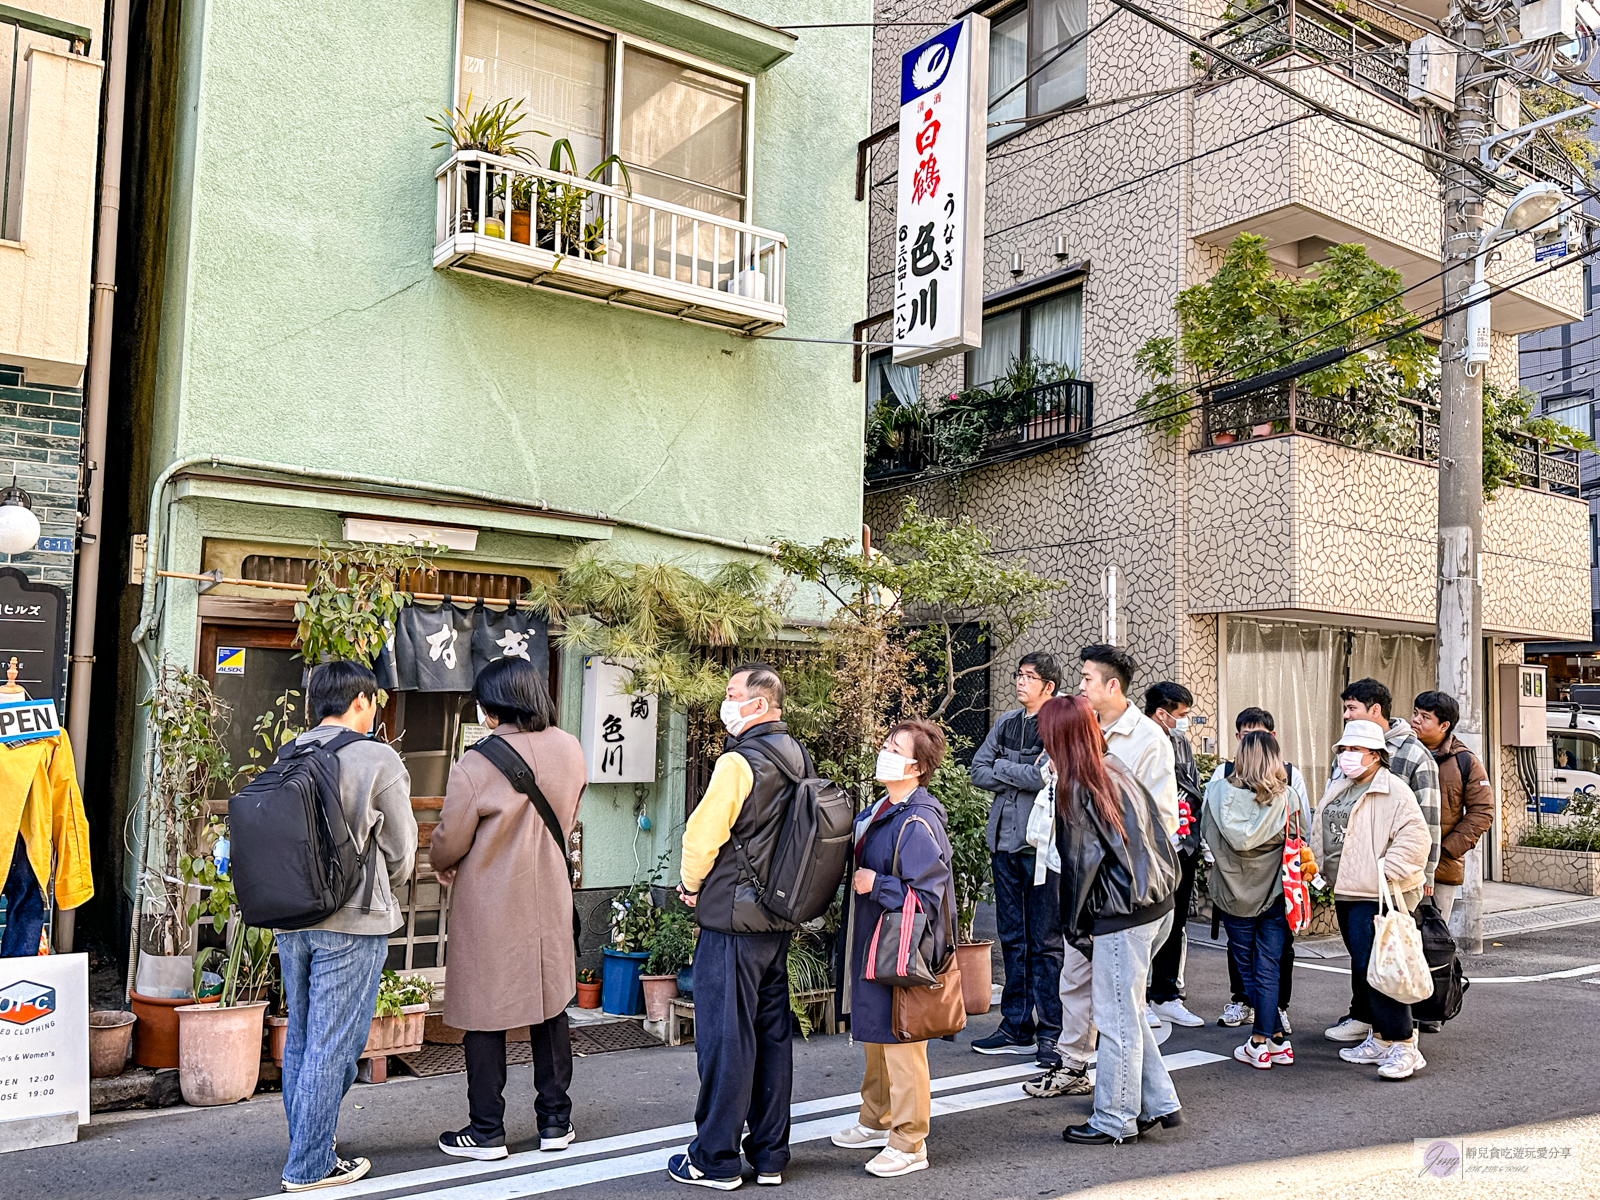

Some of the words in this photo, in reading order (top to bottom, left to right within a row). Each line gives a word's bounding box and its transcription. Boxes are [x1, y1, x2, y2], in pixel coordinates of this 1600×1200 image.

[912, 107, 941, 205] 白鶴
[941, 193, 955, 271] うなぎ
[907, 221, 940, 334] 色川
[43, 540, 68, 550] 6-11
[0, 603, 41, 616] ヒルズ
[601, 714, 625, 776] 色川
[14, 1020, 56, 1036] CLOTHING
[14, 1053, 20, 1061] &
[22, 1050, 55, 1060] Women's
[29, 1074, 55, 1084] 12:00
[28, 1088, 55, 1098] 19:00
